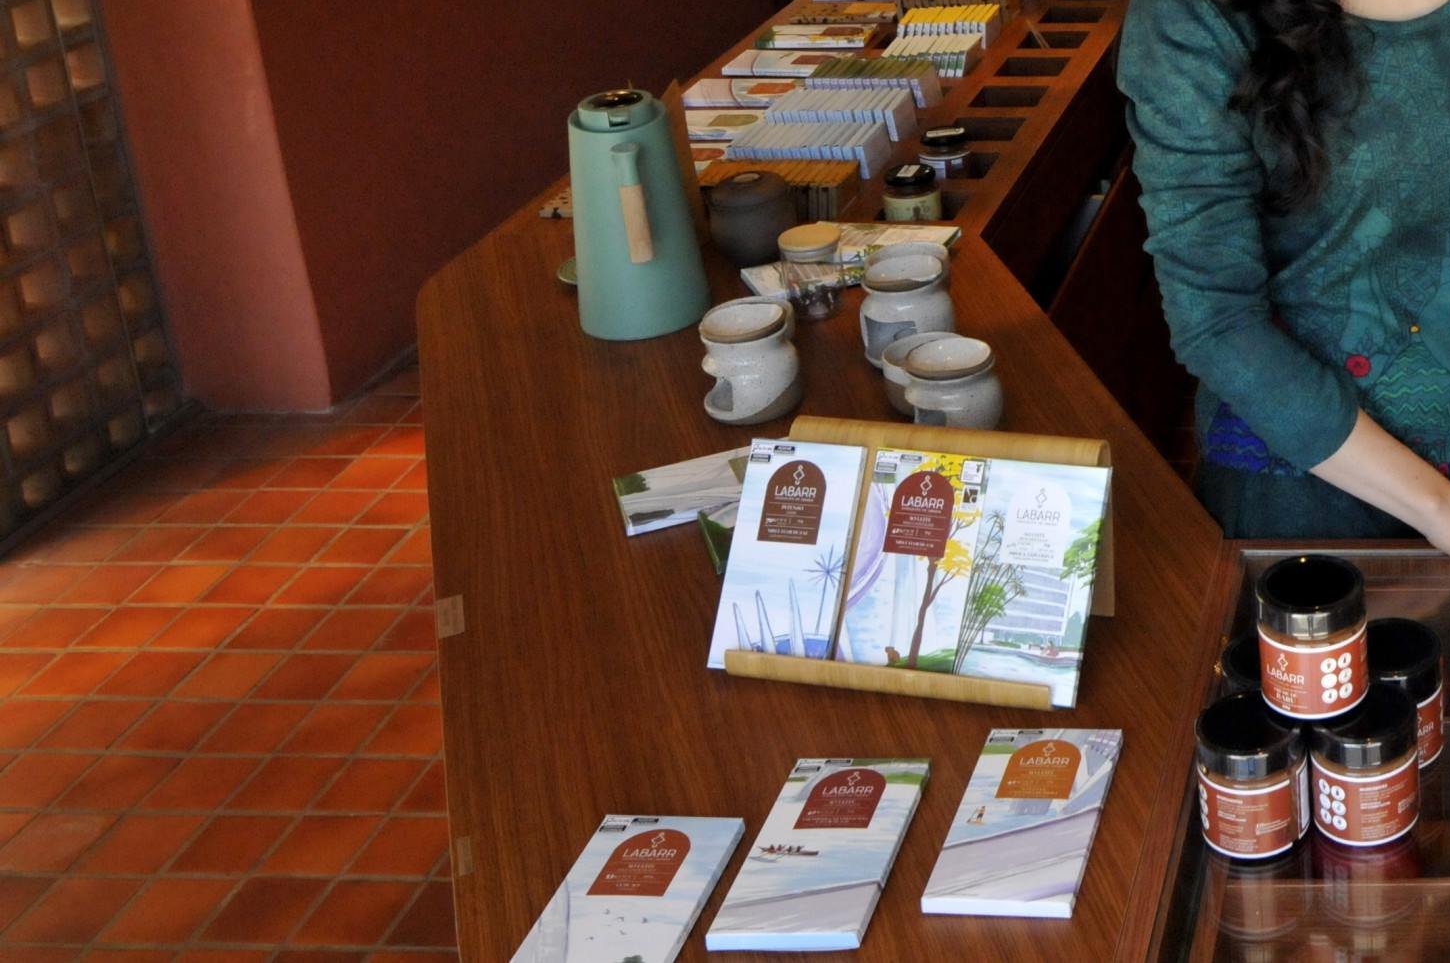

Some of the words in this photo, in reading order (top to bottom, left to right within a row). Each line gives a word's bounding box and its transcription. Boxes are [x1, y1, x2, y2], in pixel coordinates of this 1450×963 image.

[774, 485, 817, 499] LABARR
[901, 496, 945, 509] LABARR
[1016, 509, 1061, 522] LABARR
[1266, 664, 1305, 686] LABARR
[1020, 757, 1070, 766] LABARR
[822, 786, 875, 795] LABARR
[622, 849, 677, 858] LABARR
